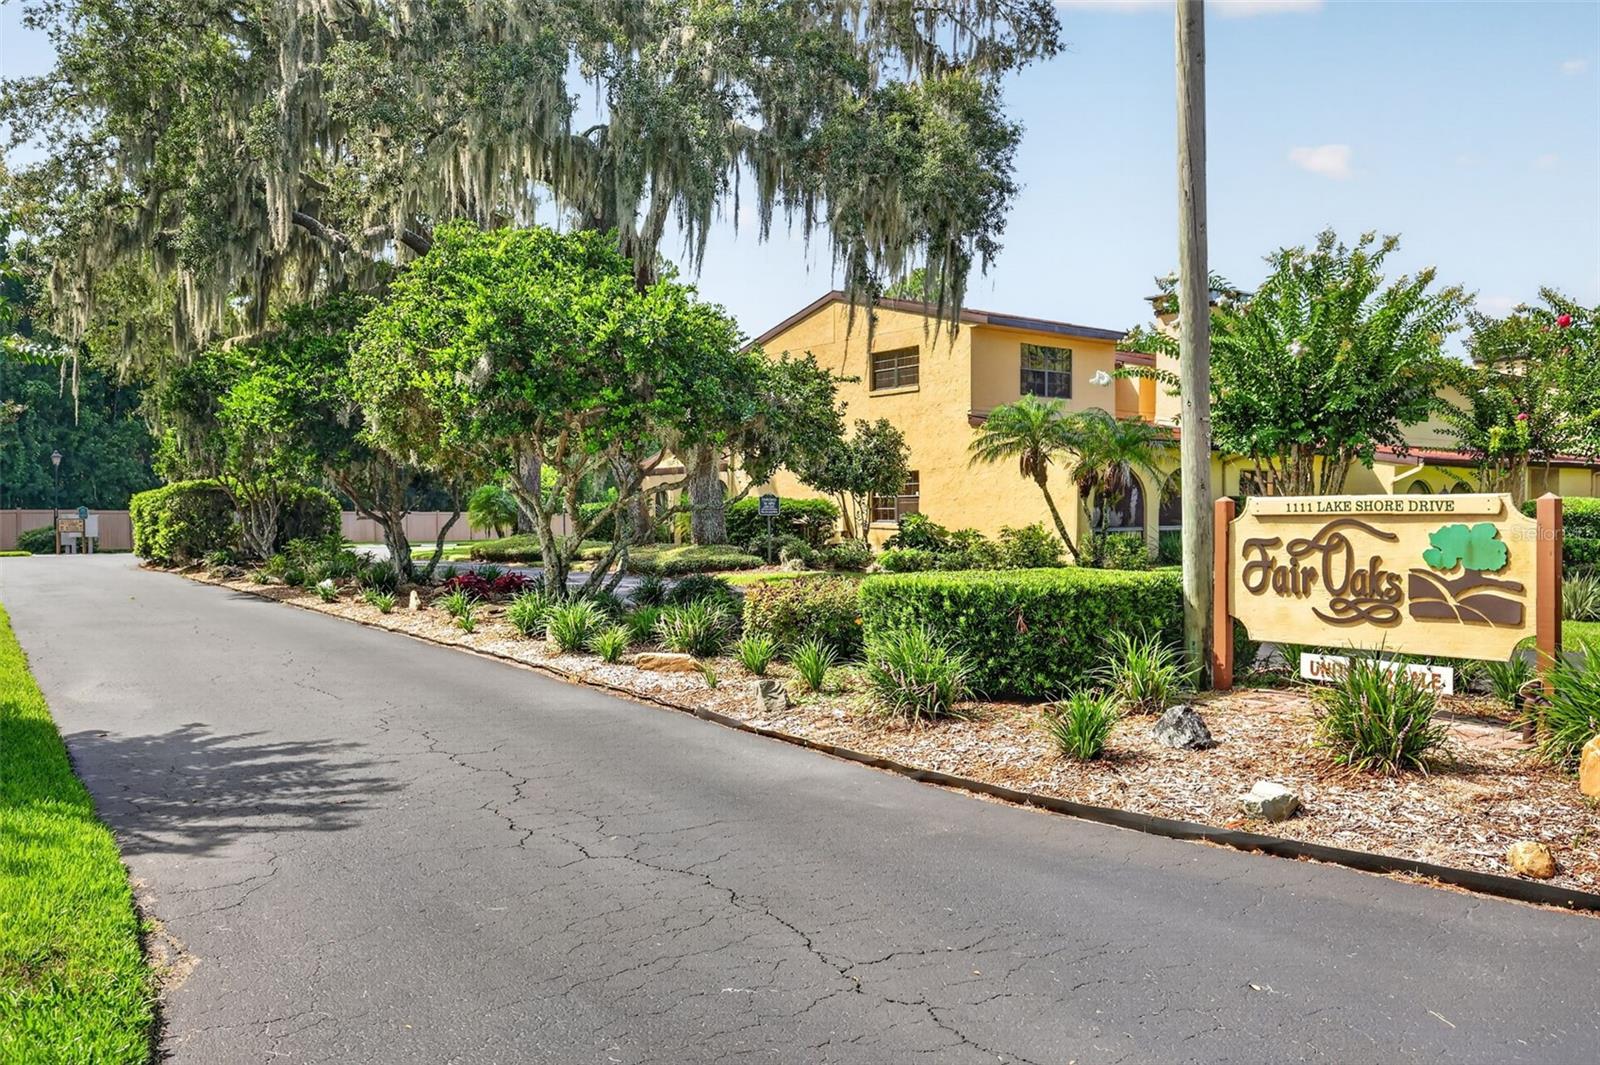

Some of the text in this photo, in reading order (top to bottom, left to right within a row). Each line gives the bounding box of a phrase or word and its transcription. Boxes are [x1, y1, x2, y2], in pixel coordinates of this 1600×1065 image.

[1286, 500, 1455, 513] 1111 LAKE SHORE DRIVE
[1241, 519, 1404, 606] Fair Oaks
